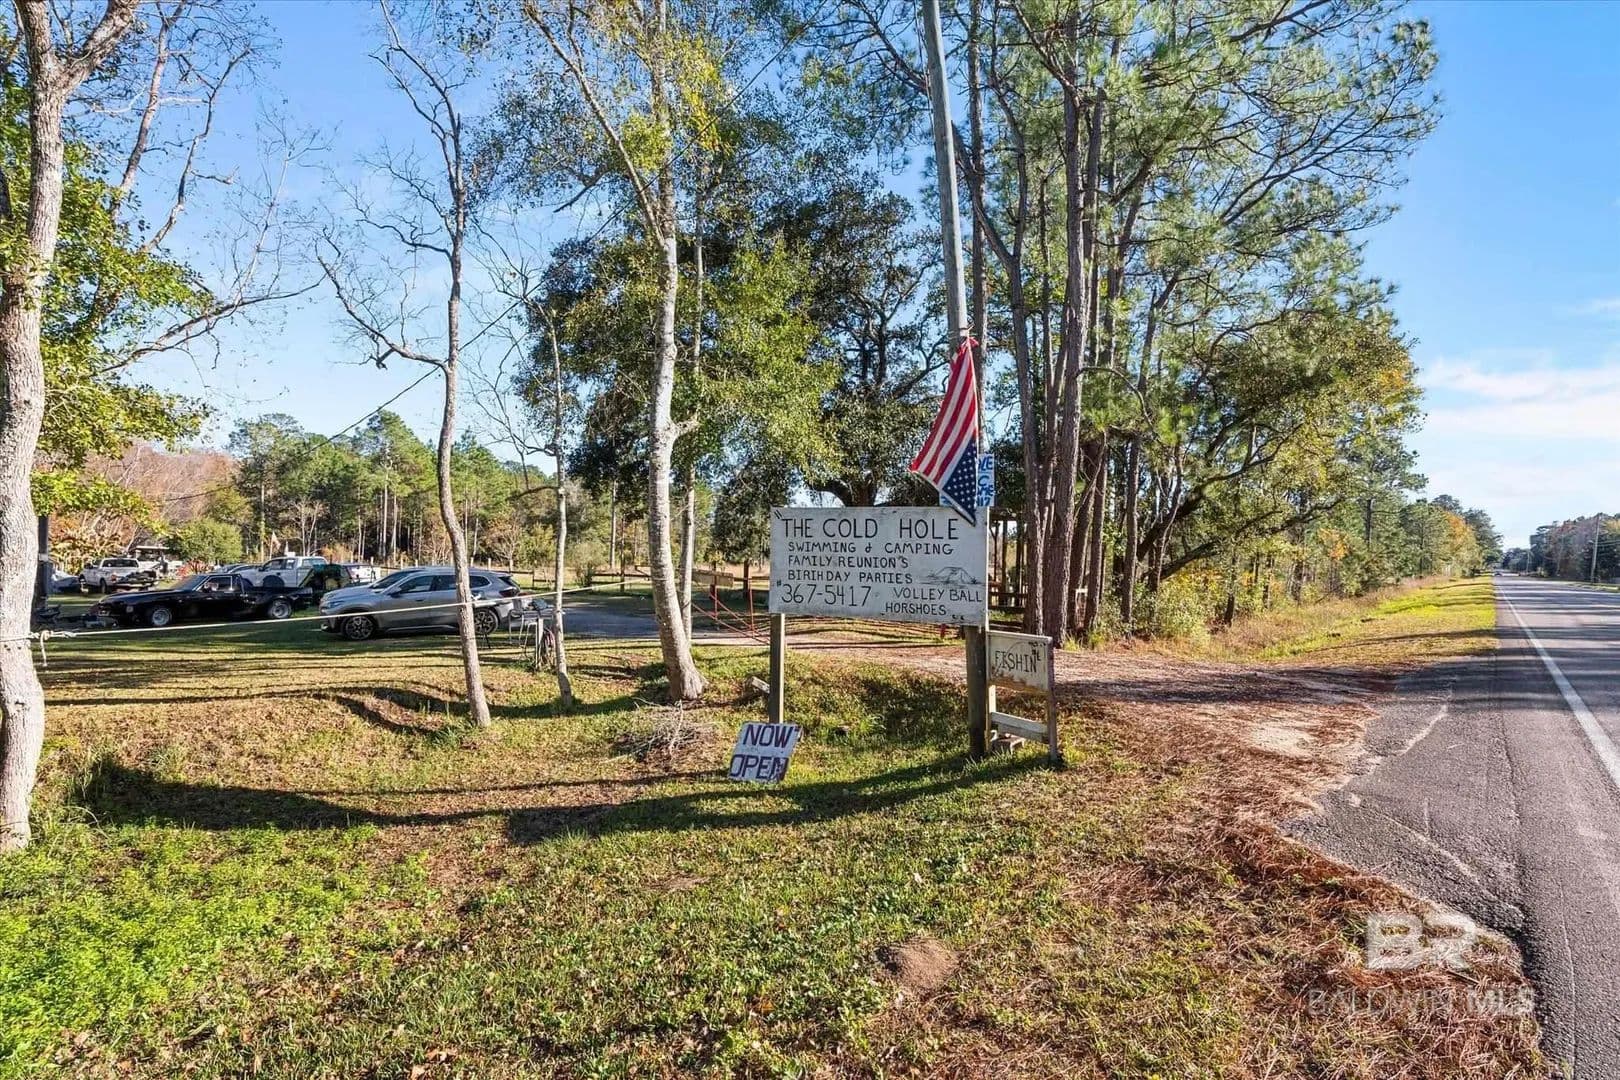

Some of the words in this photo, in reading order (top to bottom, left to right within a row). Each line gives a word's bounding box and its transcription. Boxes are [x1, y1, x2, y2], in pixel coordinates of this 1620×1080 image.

[822, 518, 878, 538] COLD
[899, 518, 959, 539] HOLE
[788, 541, 856, 553] SWIMMING
[884, 542, 954, 555] CAMPING
[788, 555, 832, 567] FAMILY
[859, 571, 913, 584] PARTIES
[893, 587, 945, 600] VOLLEY
[949, 589, 982, 602] BALL
[885, 602, 947, 616] HORSHOES
[743, 724, 793, 748] NOW
[729, 754, 789, 781] OPEN
